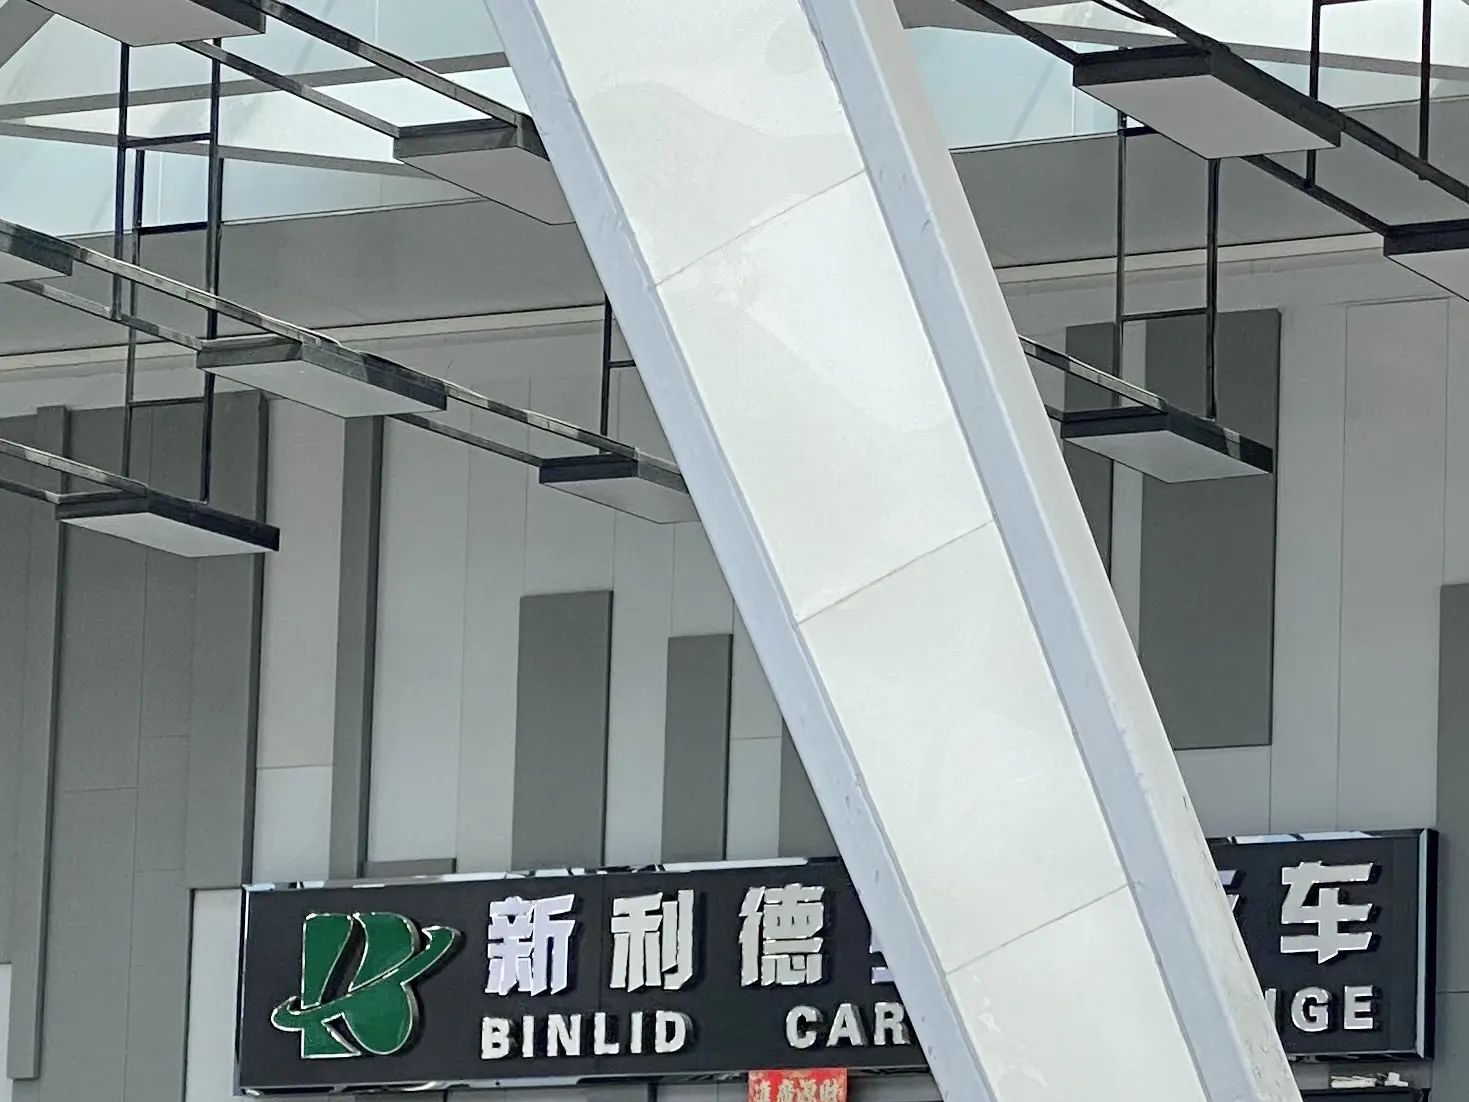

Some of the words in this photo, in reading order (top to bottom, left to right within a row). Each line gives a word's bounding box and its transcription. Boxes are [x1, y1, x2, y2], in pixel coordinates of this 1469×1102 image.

[486, 883, 893, 997] 新利德
[481, 1011, 689, 1060] BINLID
[786, 1001, 908, 1049] CAR
